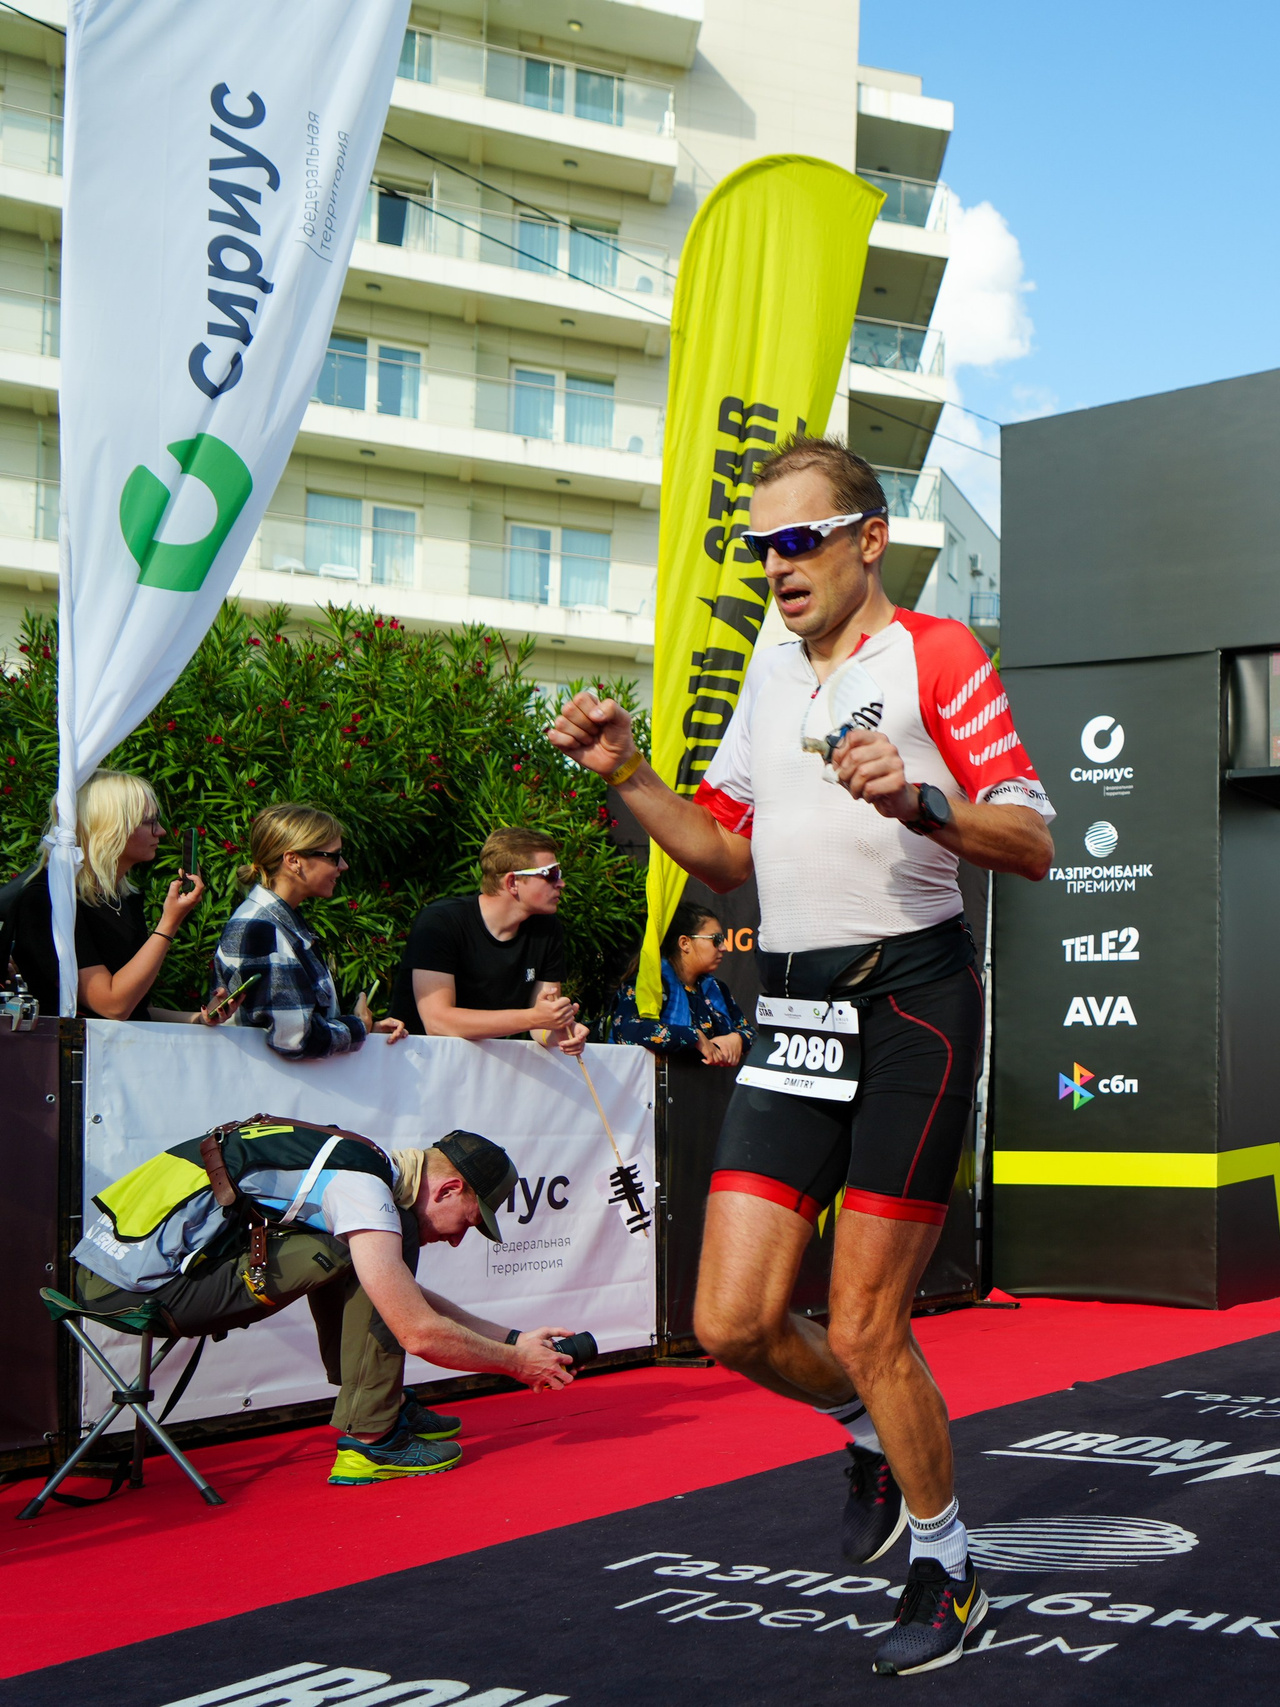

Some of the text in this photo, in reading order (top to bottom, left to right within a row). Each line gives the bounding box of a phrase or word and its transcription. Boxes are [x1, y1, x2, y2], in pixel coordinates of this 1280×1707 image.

[301, 110, 320, 239] федеральная
[319, 130, 350, 252] территория
[188, 82, 280, 400] Сириус
[674, 647, 745, 791] RON
[1070, 767, 1134, 784] Сириус
[1049, 863, 1154, 880] ГАЗПРОМБАНК
[1067, 879, 1136, 893] ПРЕМИУМ
[1062, 926, 1140, 962] TELE2
[1063, 996, 1138, 1026] AVA
[766, 1032, 844, 1073] 2080
[784, 1077, 815, 1089] DMITRY
[1098, 1074, 1139, 1093] сбп
[492, 1235, 571, 1255] федеральная
[492, 1257, 563, 1276] территория
[1007, 1430, 1232, 1461] IRON
[614, 1588, 1119, 1662] Премум
